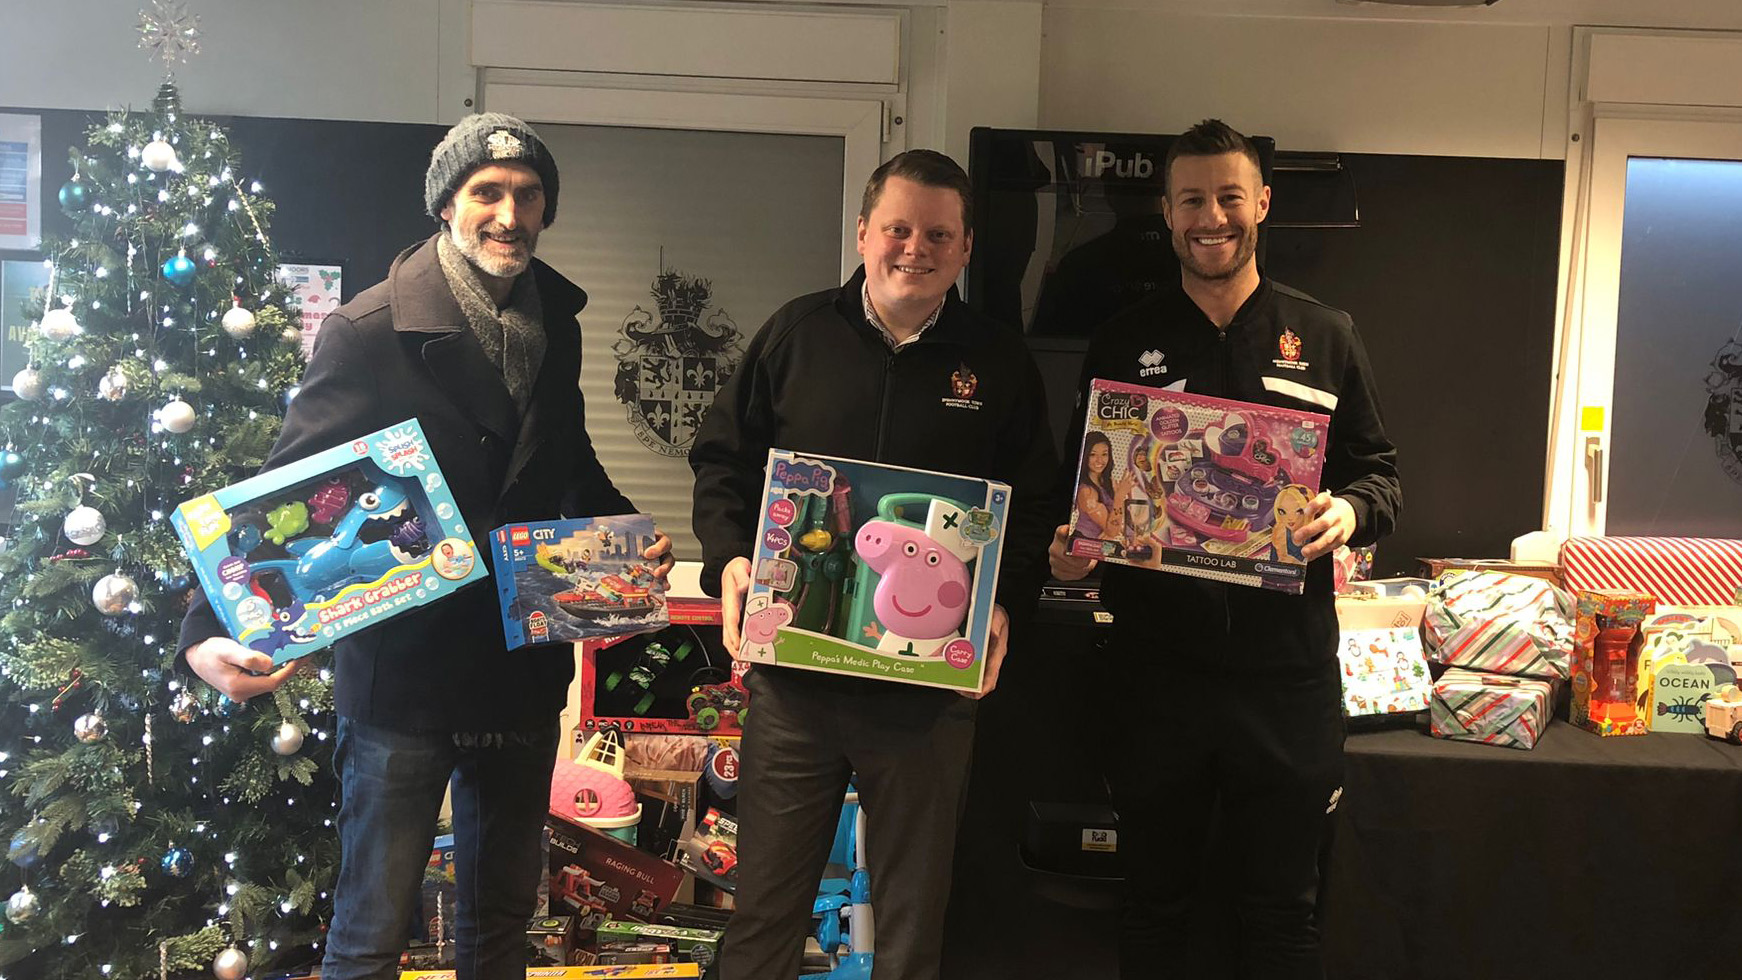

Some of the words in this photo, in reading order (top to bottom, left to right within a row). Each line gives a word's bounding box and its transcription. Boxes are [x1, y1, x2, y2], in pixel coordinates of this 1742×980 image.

[1084, 150, 1154, 178] iPub
[1140, 365, 1167, 377] errea
[1100, 405, 1140, 419] CHIC
[638, 431, 656, 449] SPE
[775, 462, 810, 486] Peppa
[811, 468, 830, 490] Pig
[532, 528, 556, 540] CITY
[513, 549, 524, 557] 5+
[1187, 555, 1219, 566] TATTOO
[1220, 560, 1237, 569] LAB
[318, 596, 365, 624] Shark
[363, 572, 422, 604] Grabber
[811, 651, 840, 664] Peppa's
[843, 655, 870, 668] Medic
[872, 659, 890, 672] Play
[893, 663, 914, 674] Case
[1659, 677, 1710, 689] OCEAN
[724, 765, 735, 778] 23
[605, 857, 637, 876] RAGING
[636, 870, 655, 885] BULL
